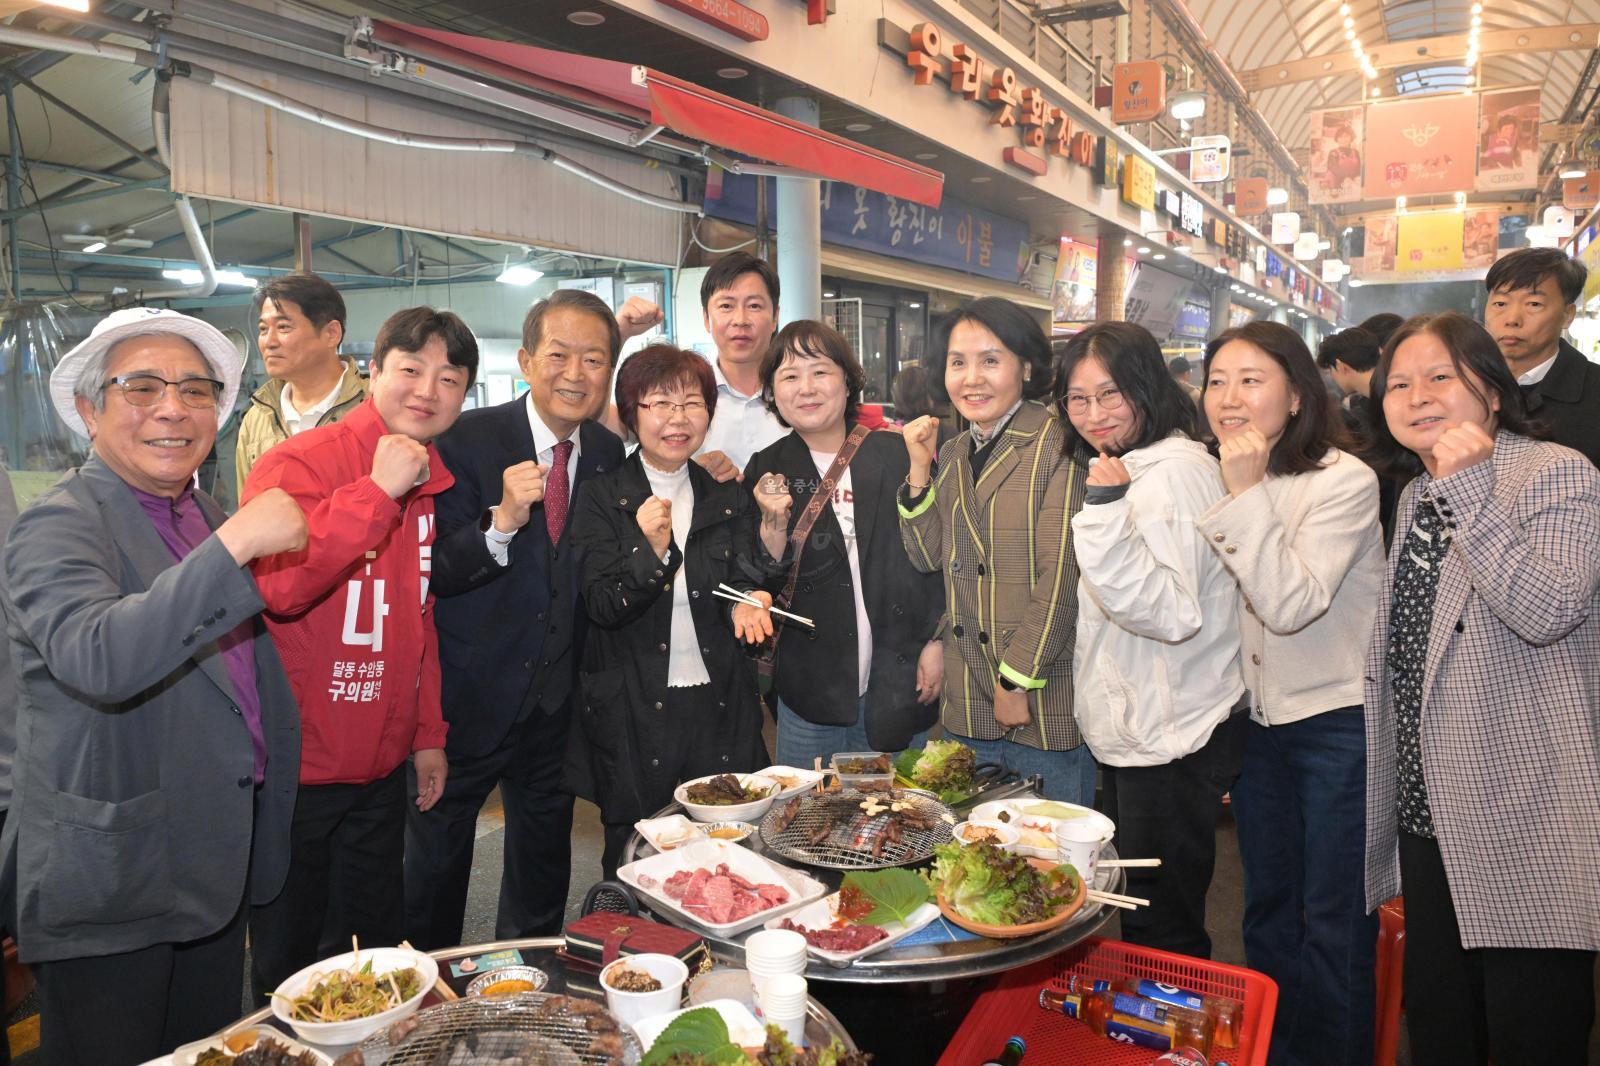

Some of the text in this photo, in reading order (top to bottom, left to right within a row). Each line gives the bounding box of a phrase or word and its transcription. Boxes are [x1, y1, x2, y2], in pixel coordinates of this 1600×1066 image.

[341, 579, 390, 653] 나
[332, 660, 385, 679] 달동 수암동
[328, 680, 375, 703] 구의원
